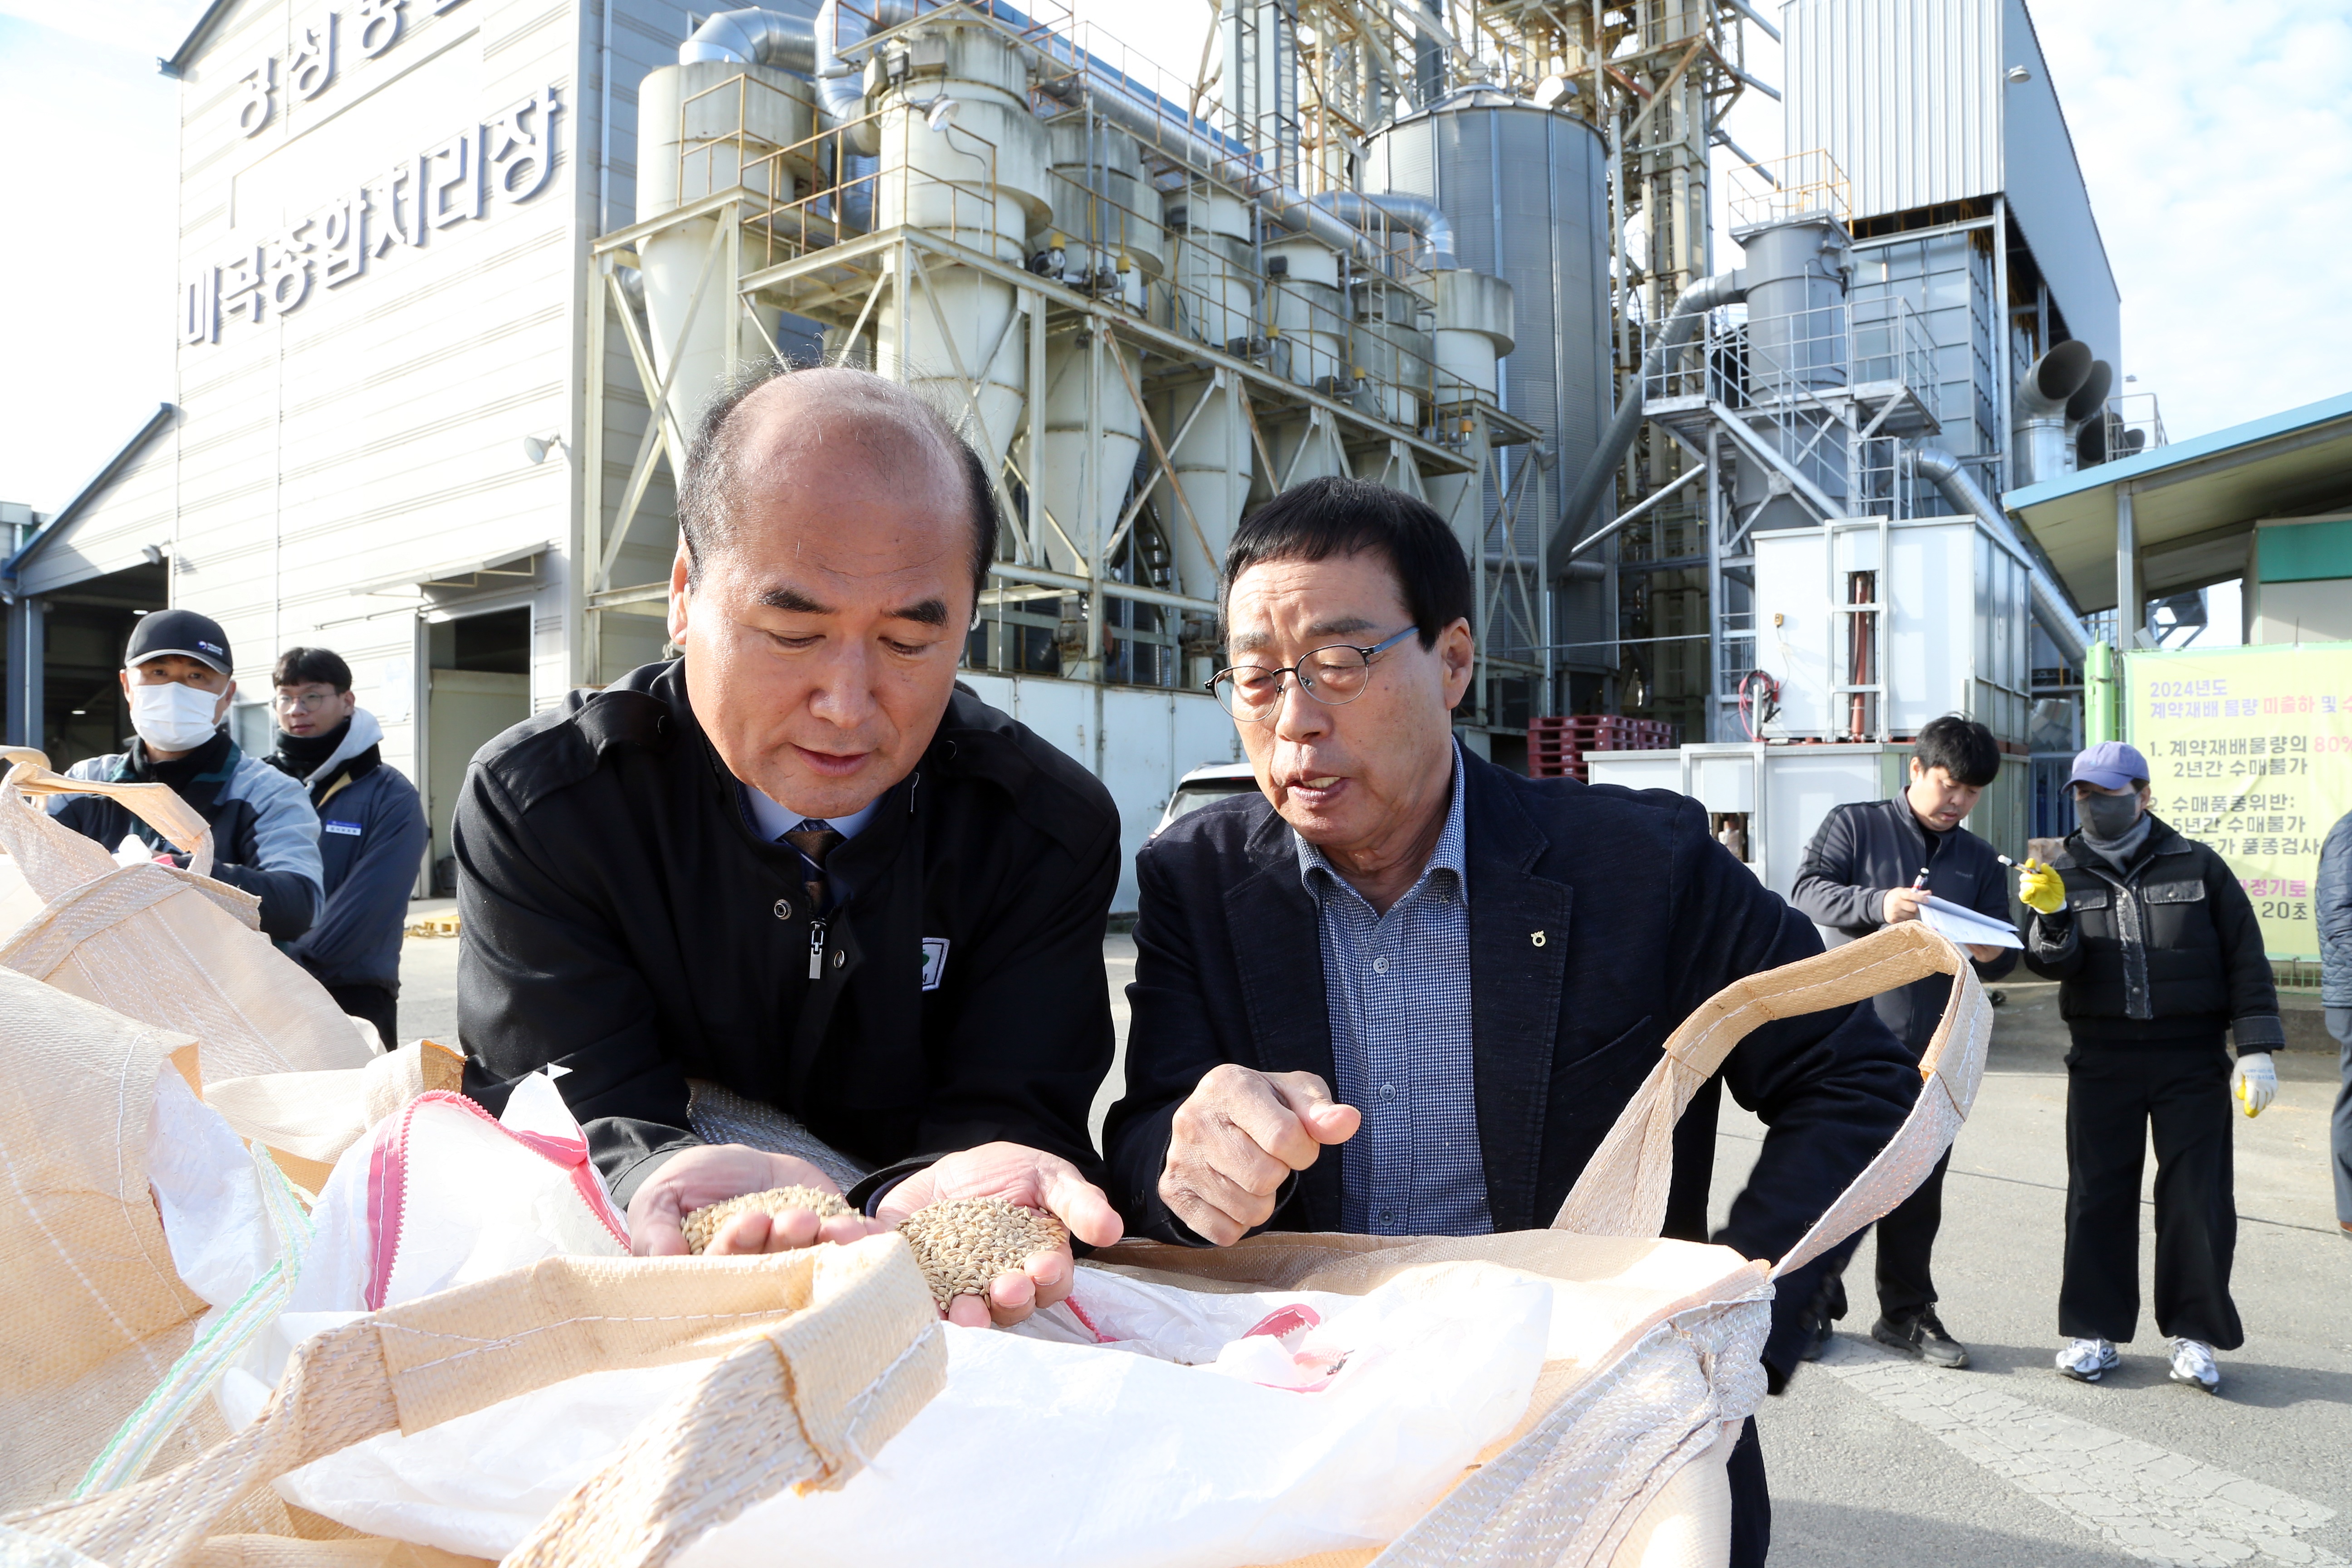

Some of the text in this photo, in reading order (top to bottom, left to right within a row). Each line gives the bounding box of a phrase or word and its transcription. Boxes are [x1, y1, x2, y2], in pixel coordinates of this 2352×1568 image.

[182, 84, 557, 344] 미곡종합처리장
[2150, 679, 2228, 697] 2024년도
[2150, 700, 2219, 719] 계약재배
[2225, 699, 2258, 717] 물량
[2264, 695, 2315, 714] 미출하
[2321, 696, 2337, 713] 및
[2150, 741, 2162, 756] 1.
[2170, 735, 2307, 757] 계약재배물량의
[2174, 758, 2308, 778] 2년간 수매불가
[2150, 794, 2294, 813] 2. 수매품종위반:
[2172, 815, 2306, 833] 5년간 수매불가
[2262, 901, 2308, 920] 20초
